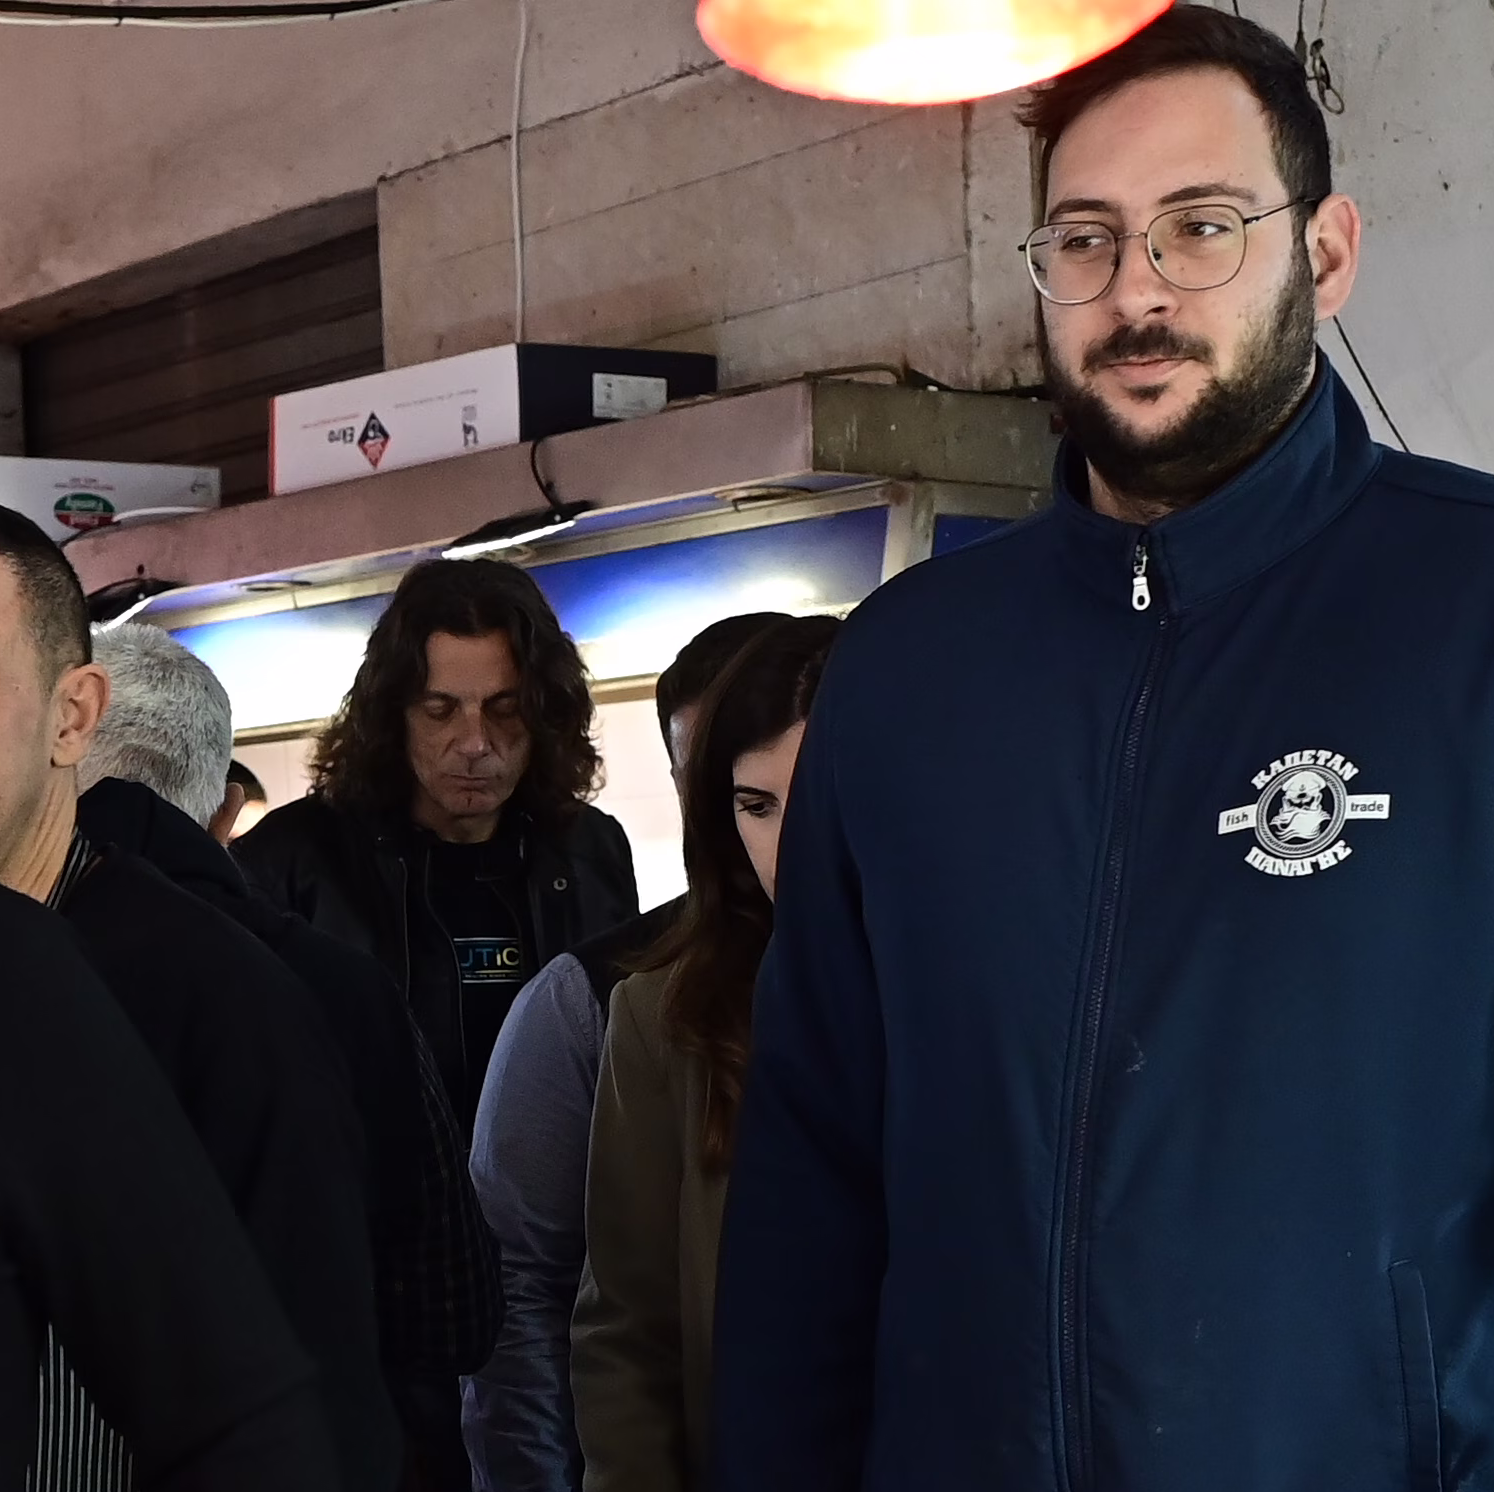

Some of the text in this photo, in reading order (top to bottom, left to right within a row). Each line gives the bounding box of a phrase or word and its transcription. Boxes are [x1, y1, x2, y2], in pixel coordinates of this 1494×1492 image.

[1251, 749, 1359, 790] ΚΑΠΕΤΑΝ
[1225, 801, 1385, 827] fish trade
[1244, 840, 1353, 877] ΠΑΝΑΓΗΣ
